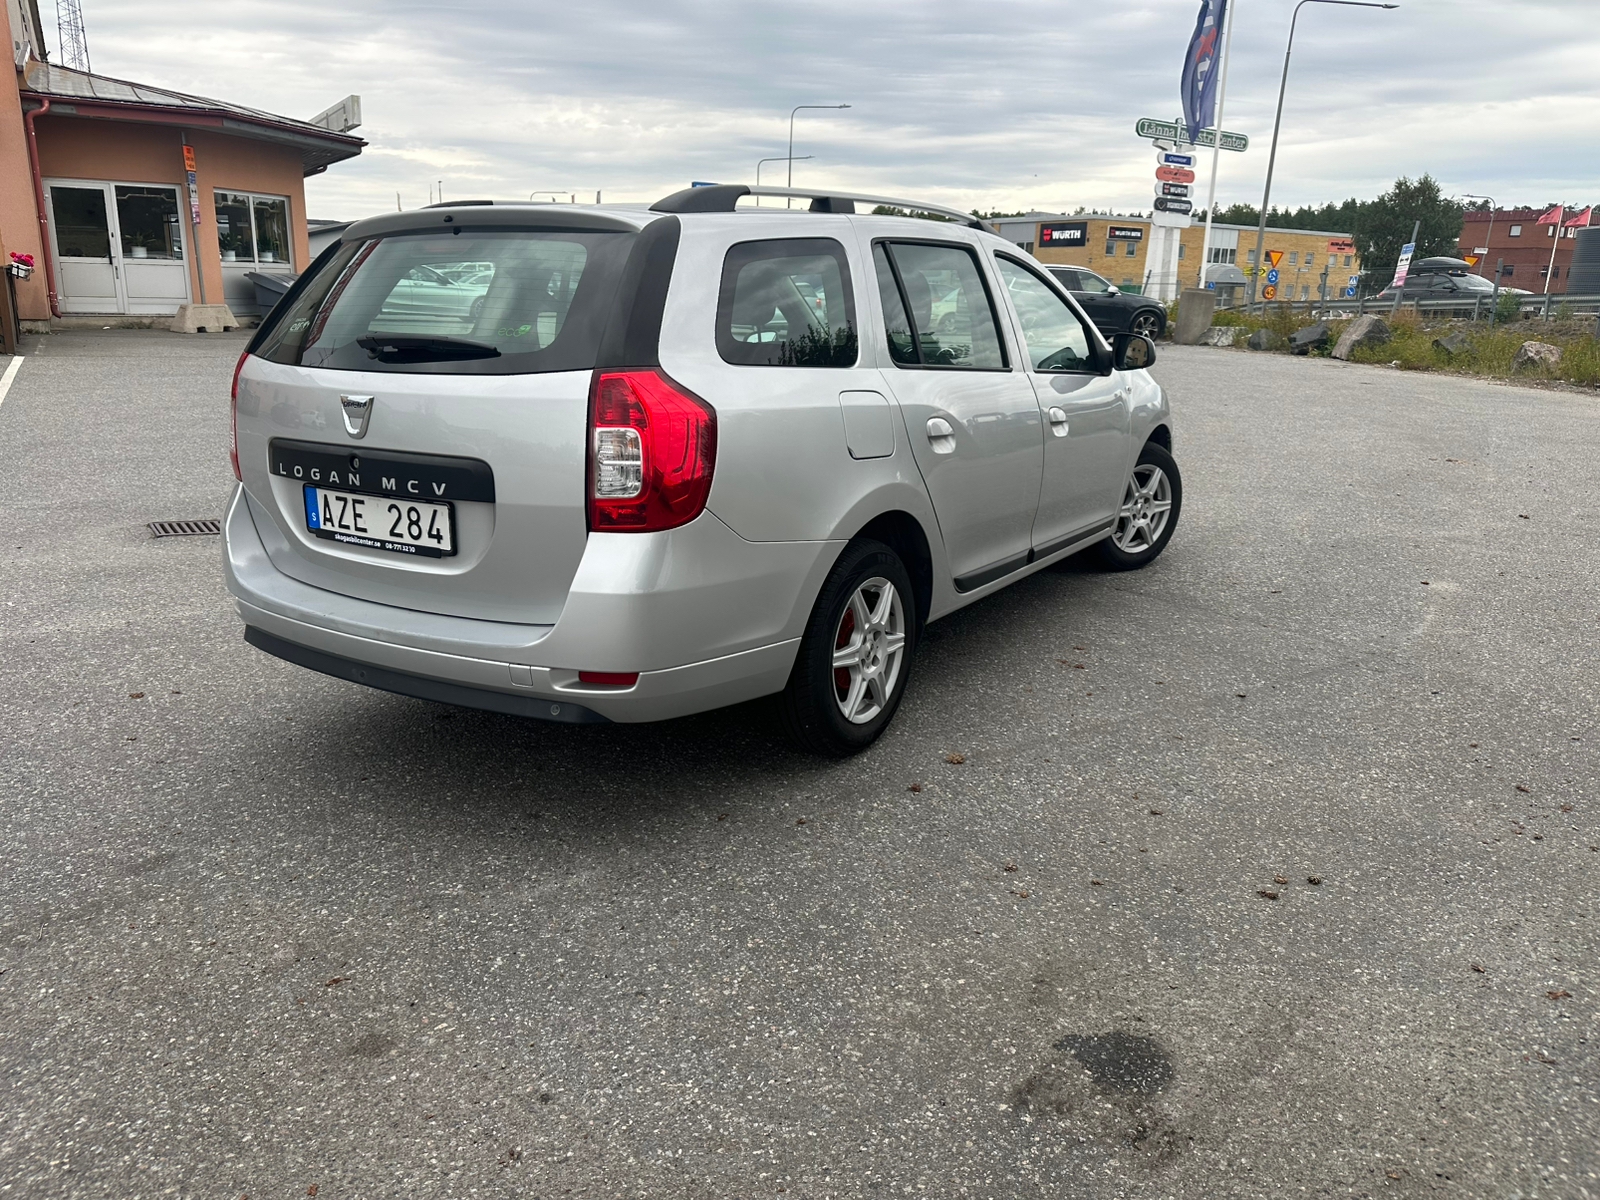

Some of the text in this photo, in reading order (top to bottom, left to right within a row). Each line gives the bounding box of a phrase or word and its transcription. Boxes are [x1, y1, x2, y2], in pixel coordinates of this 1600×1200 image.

[1143, 122, 1175, 137] Länna
[279, 462, 446, 496] LOGAN MCV
[311, 512, 317, 522] S
[322, 494, 444, 545] AZE 284
